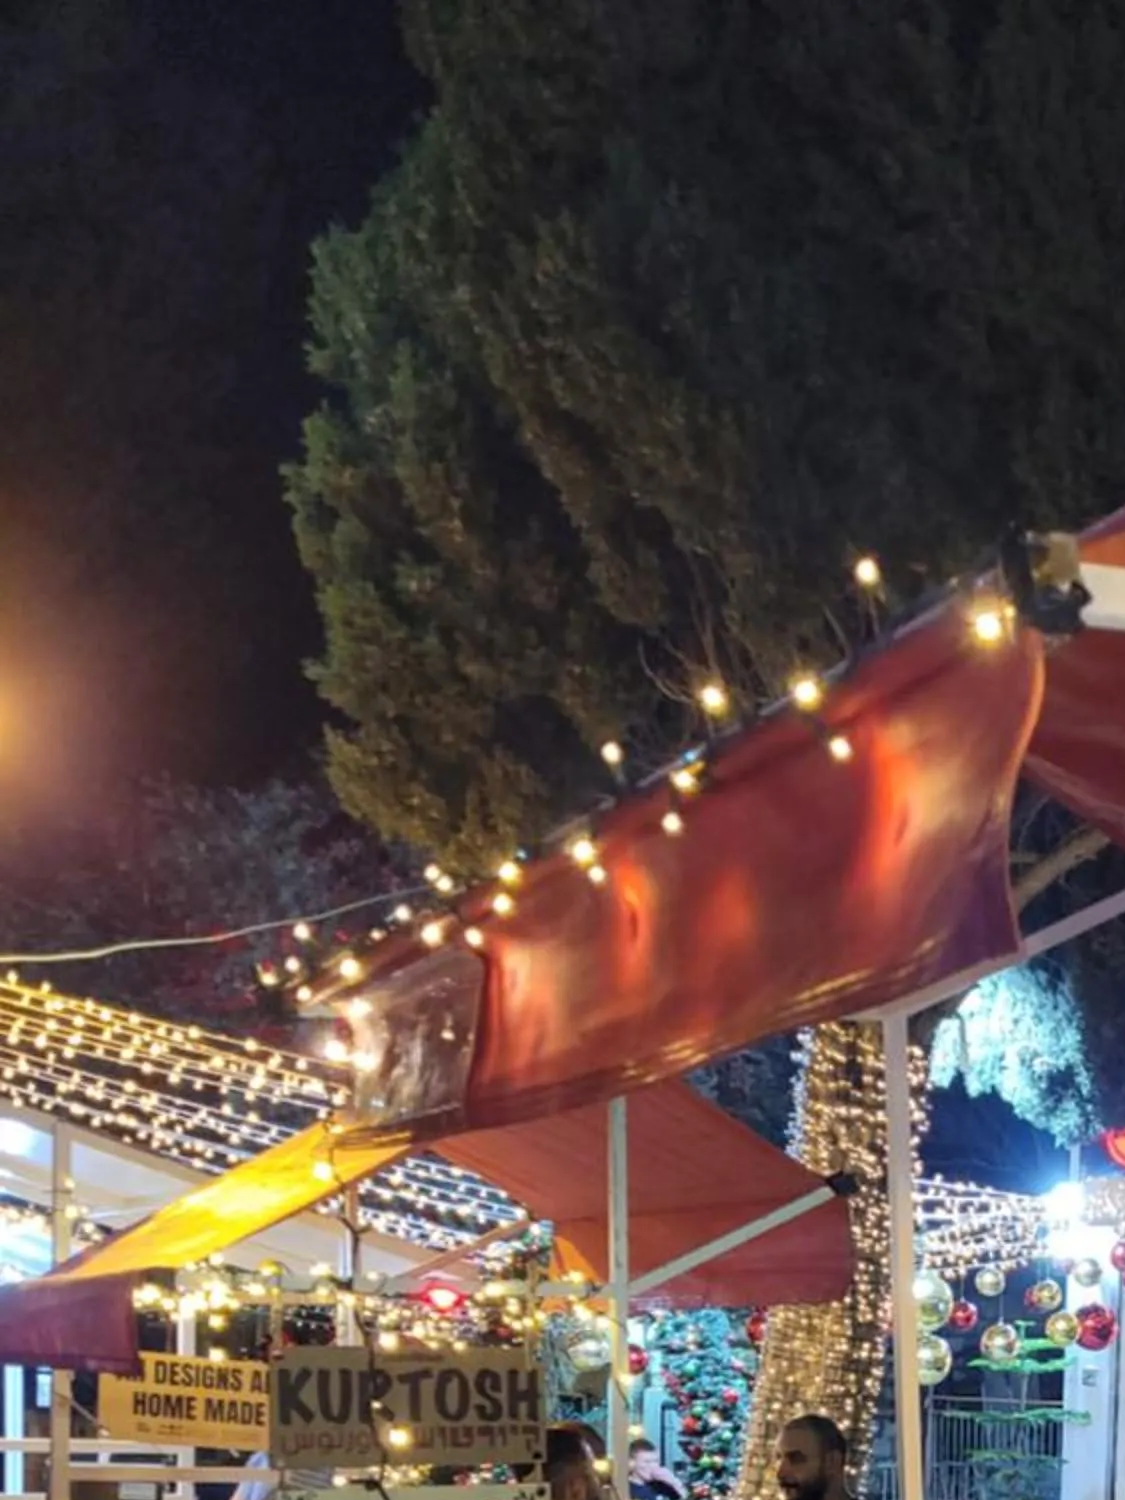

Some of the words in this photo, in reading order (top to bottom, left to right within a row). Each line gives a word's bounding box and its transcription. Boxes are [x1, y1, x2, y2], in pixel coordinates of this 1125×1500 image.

[154, 1360, 243, 1392] DESIGNS
[132, 1391, 198, 1421] HOME
[204, 1397, 267, 1427] MADE
[277, 1367, 541, 1426] KURTOSH
